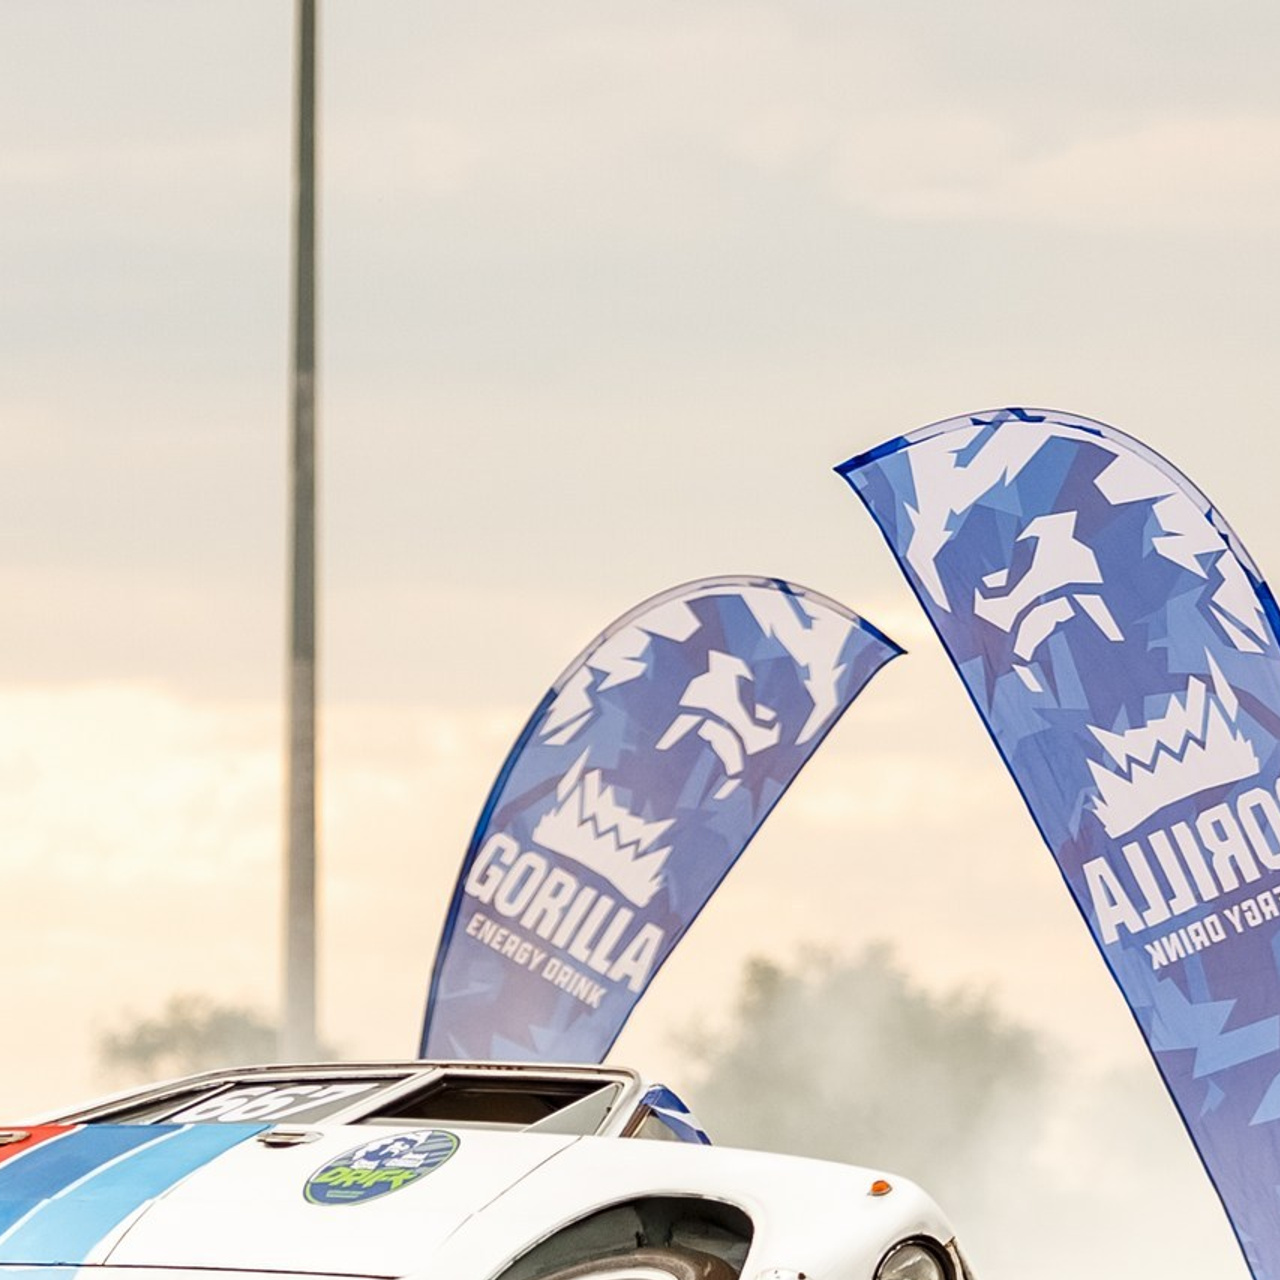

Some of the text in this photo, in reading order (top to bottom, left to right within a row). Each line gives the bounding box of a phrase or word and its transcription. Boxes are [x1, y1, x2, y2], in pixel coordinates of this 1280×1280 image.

[464, 832, 666, 994] GORILLA
[465, 912, 608, 1009] ENERGY DRINK
[172, 1083, 381, 1122] 667
